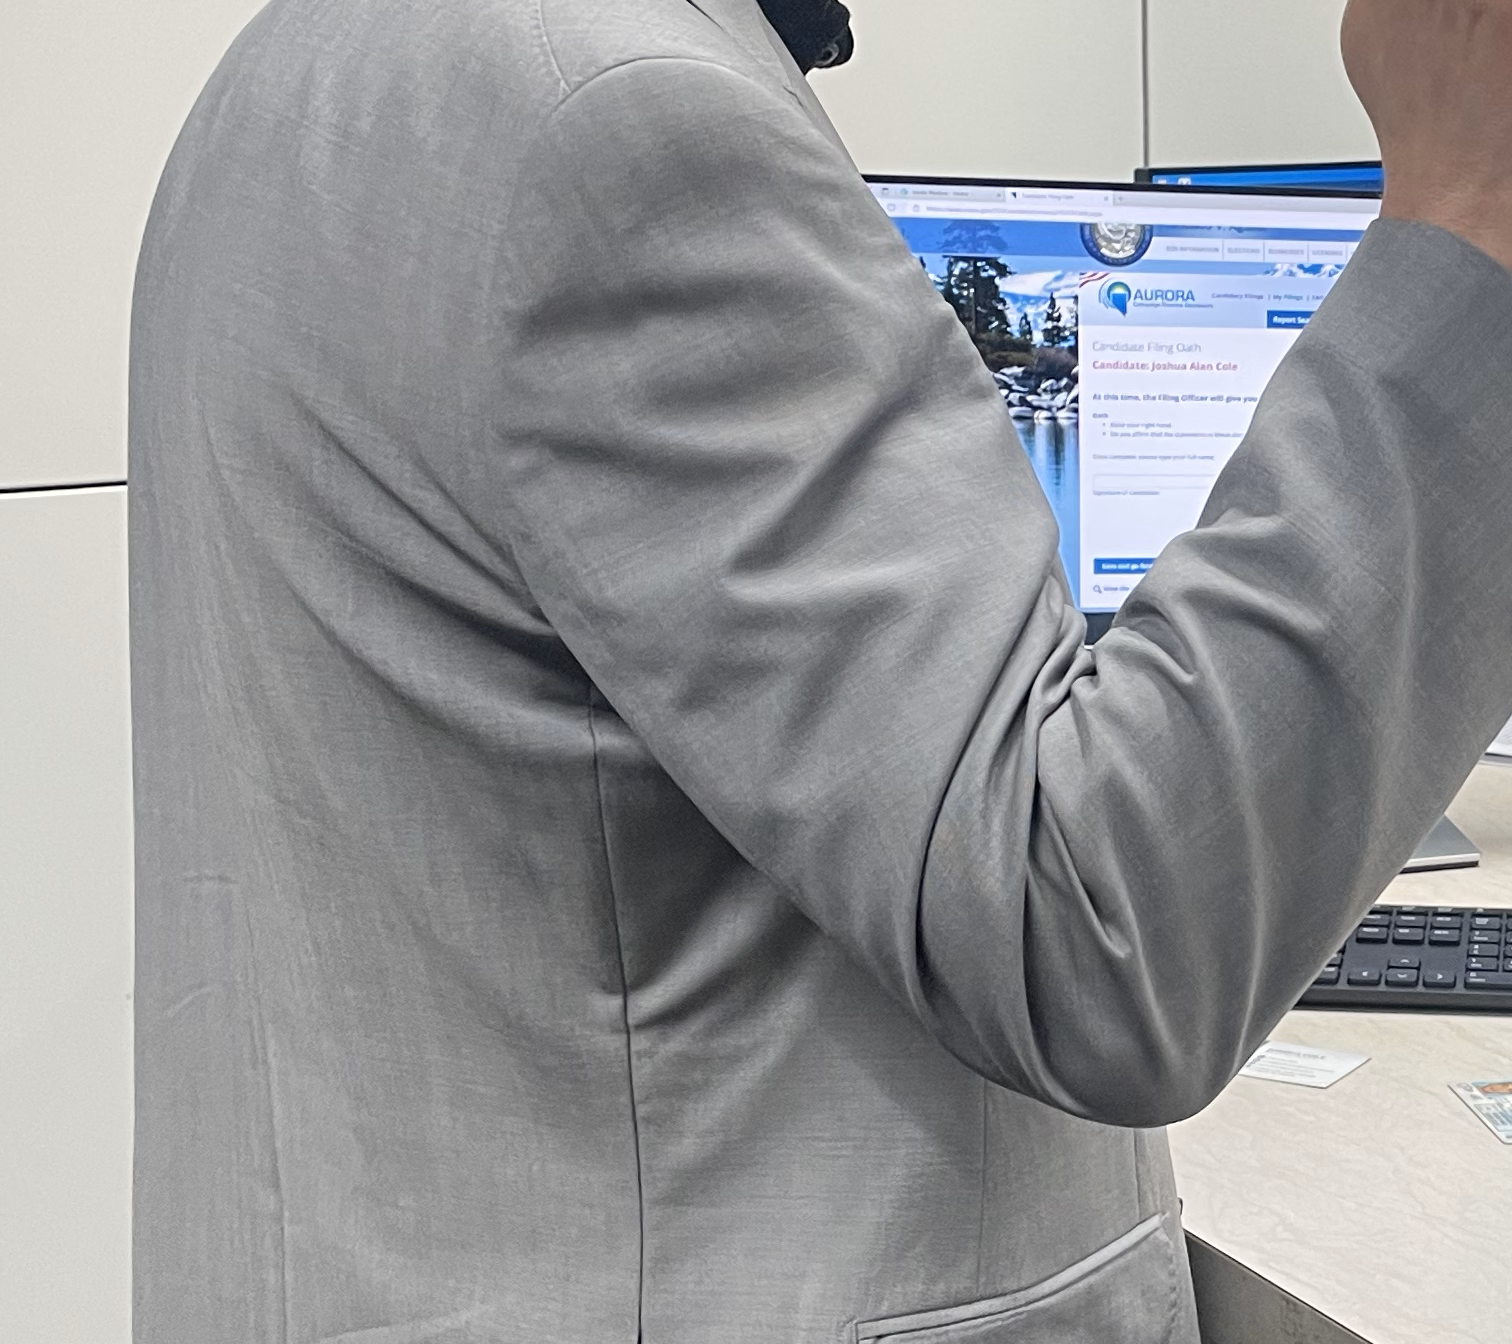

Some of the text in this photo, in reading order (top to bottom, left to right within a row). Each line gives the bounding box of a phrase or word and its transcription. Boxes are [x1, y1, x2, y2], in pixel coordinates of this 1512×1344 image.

[1133, 288, 1196, 302] AURORA
[1273, 316, 1296, 324] Report
[1092, 340, 1202, 355] Candidate Filing Oath
[1092, 360, 1238, 372] Candidate: Joshua Alan Cole
[1092, 393, 1102, 401] At
[1103, 393, 1119, 401] this
[1120, 393, 1141, 401] time,
[1181, 394, 1208, 402] Officer
[1225, 396, 1242, 404] give
